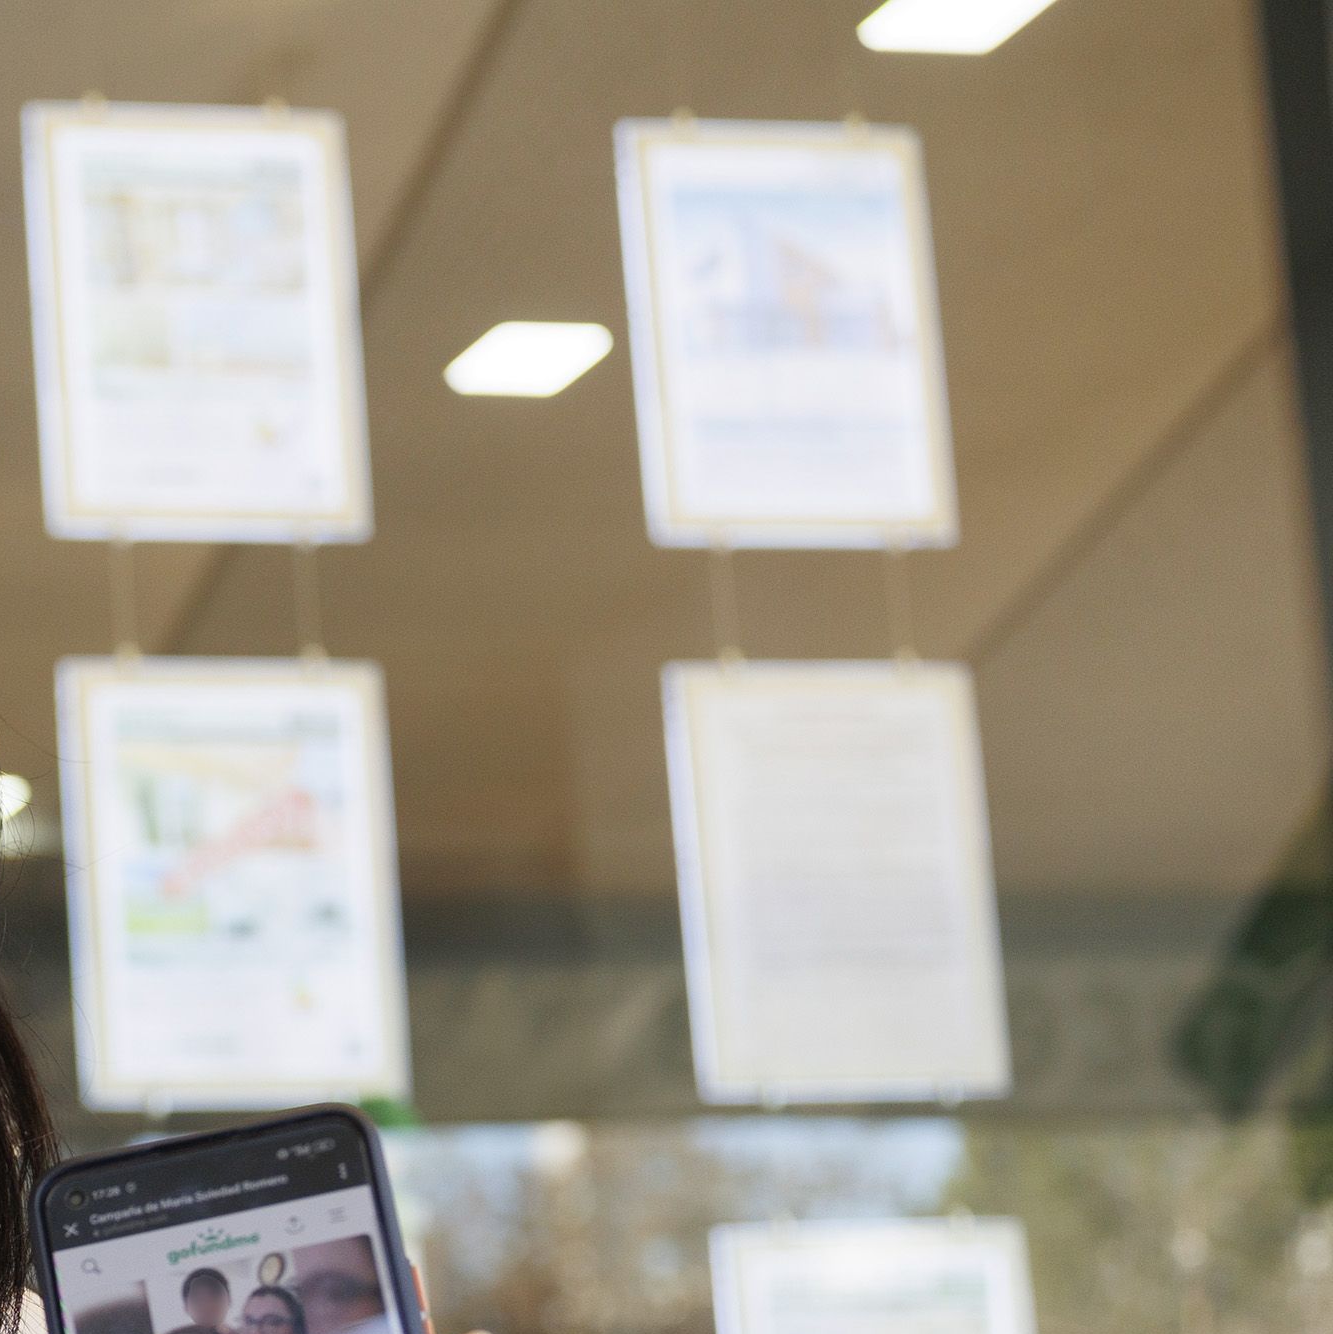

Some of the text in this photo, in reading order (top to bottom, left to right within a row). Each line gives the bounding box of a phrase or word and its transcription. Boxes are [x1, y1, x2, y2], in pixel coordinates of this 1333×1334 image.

[89, 1204, 143, 1225] Campaña
[144, 1201, 159, 1213] de
[195, 1184, 240, 1202] Soledad
[242, 1175, 288, 1191] Romero
[167, 1234, 259, 1264] gofundme
